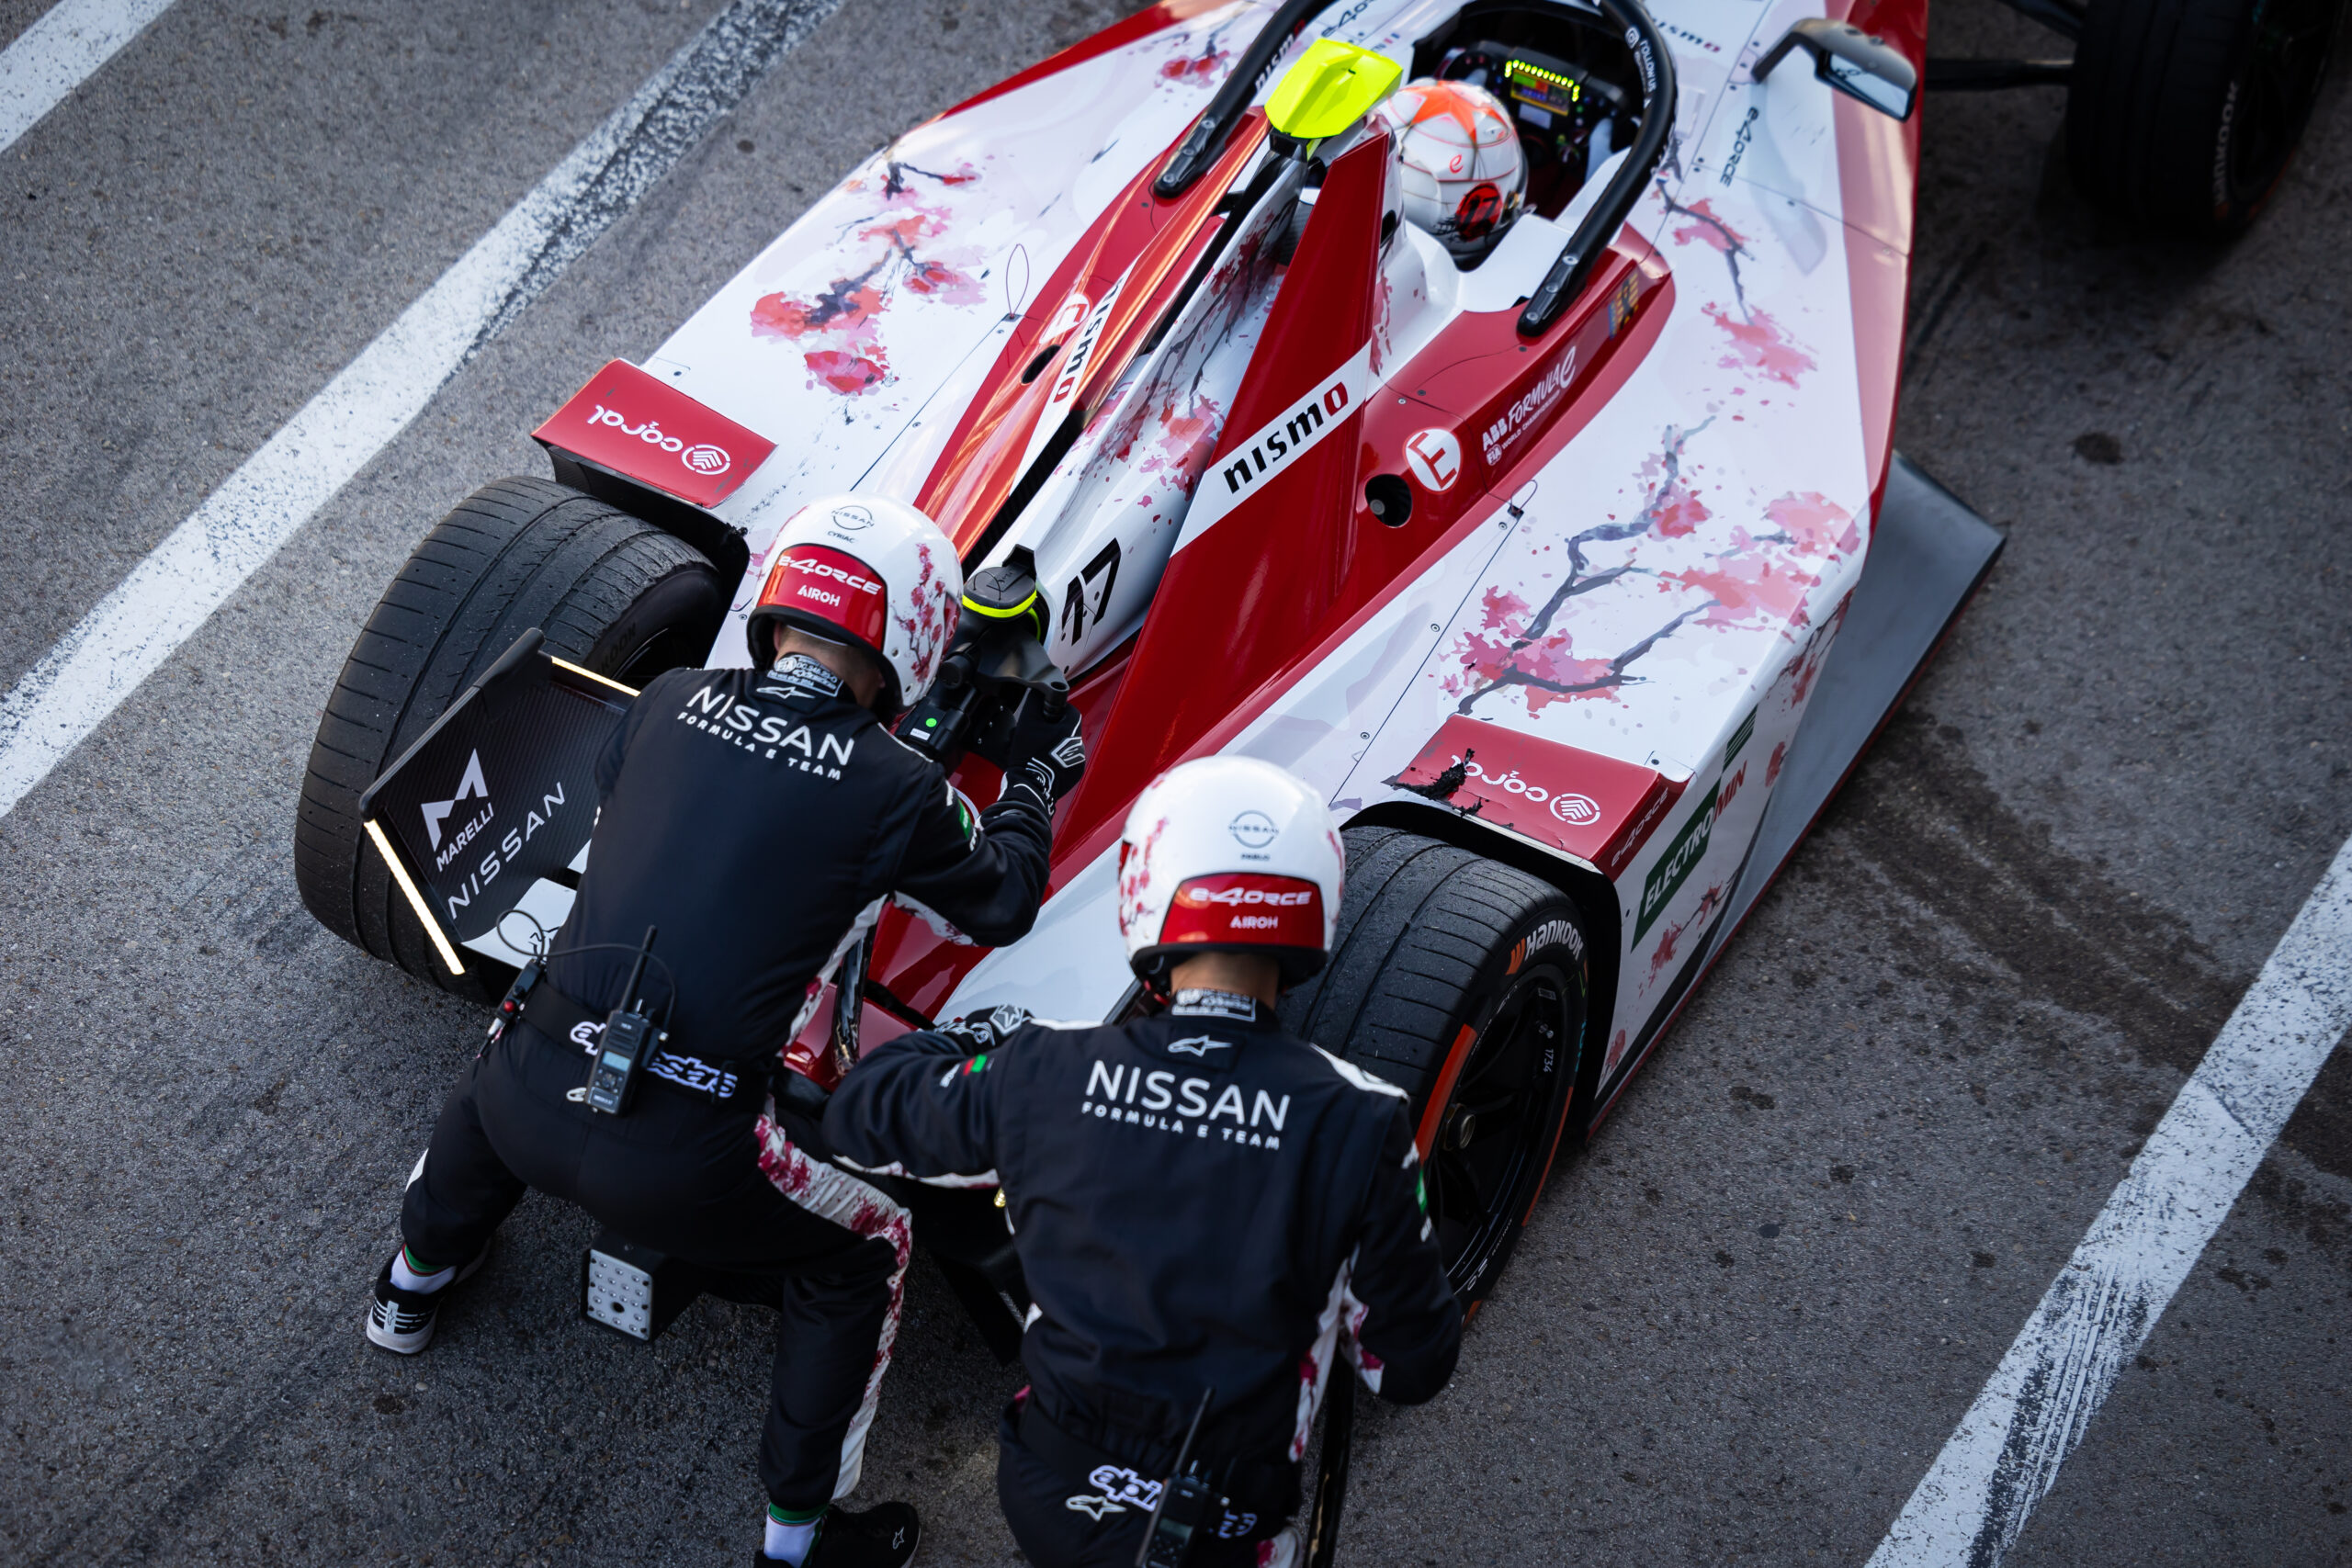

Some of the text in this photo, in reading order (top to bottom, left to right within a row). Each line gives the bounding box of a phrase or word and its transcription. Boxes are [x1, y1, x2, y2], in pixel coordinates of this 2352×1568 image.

[1254, 18, 1306, 92] nismo
[1653, 17, 1721, 53] ismo
[1222, 381, 1349, 494] nismo
[1482, 417, 1509, 452] ABB
[1508, 363, 1561, 433] FORMULA
[1407, 432, 1458, 490] E
[1487, 444, 1502, 466] FIA
[1501, 428, 1522, 450] WORLD
[827, 530, 856, 544] CYRIAC
[830, 509, 875, 528] NISSAN
[797, 584, 841, 607] AIROH
[1061, 537, 1123, 646] 17
[677, 711, 842, 781] FORMULA E TEAM
[686, 686, 854, 767] NISSAN
[435, 802, 495, 873] MARELLI
[447, 781, 566, 920] NISSAN
[1227, 824, 1280, 835] NISSAN
[1229, 914, 1279, 930] AIROH
[1082, 1100, 1281, 1150] FORMULA E TEAM
[1085, 1059, 1291, 1132] NISSAN
